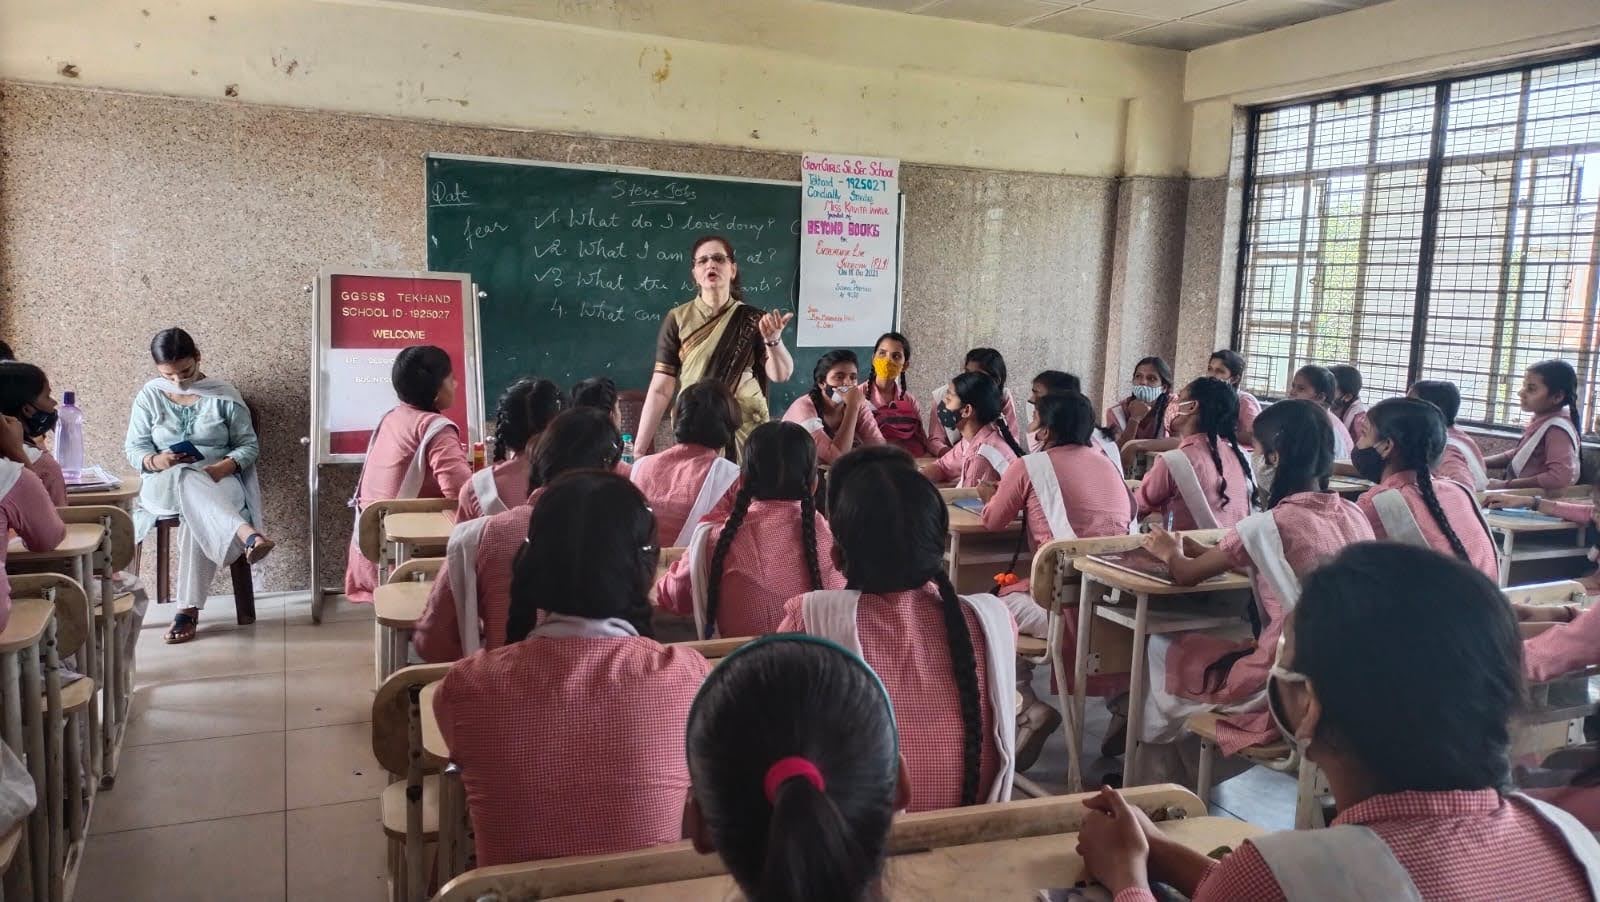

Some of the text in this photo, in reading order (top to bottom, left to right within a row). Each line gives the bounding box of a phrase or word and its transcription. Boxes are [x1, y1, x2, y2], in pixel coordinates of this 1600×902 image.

[432, 180, 470, 202] Date
[611, 179, 697, 200] Steve Jobs
[846, 177, 886, 192] 1925027
[569, 208, 617, 228] What
[631, 213, 652, 230] do
[660, 213, 674, 229] I
[682, 215, 721, 231] love
[807, 220, 843, 235] BEYOND
[848, 222, 880, 237] BOOKS
[463, 215, 509, 250] fear
[579, 238, 627, 260] What
[636, 241, 649, 259] I
[656, 249, 683, 262] am
[576, 268, 625, 291] What
[341, 291, 451, 304] GGSSS TEKHAND
[342, 307, 389, 318] SCHOOL
[392, 309, 402, 318] ID
[410, 310, 450, 319] 1925027
[580, 300, 625, 322] What
[373, 330, 426, 340] WELCOME
